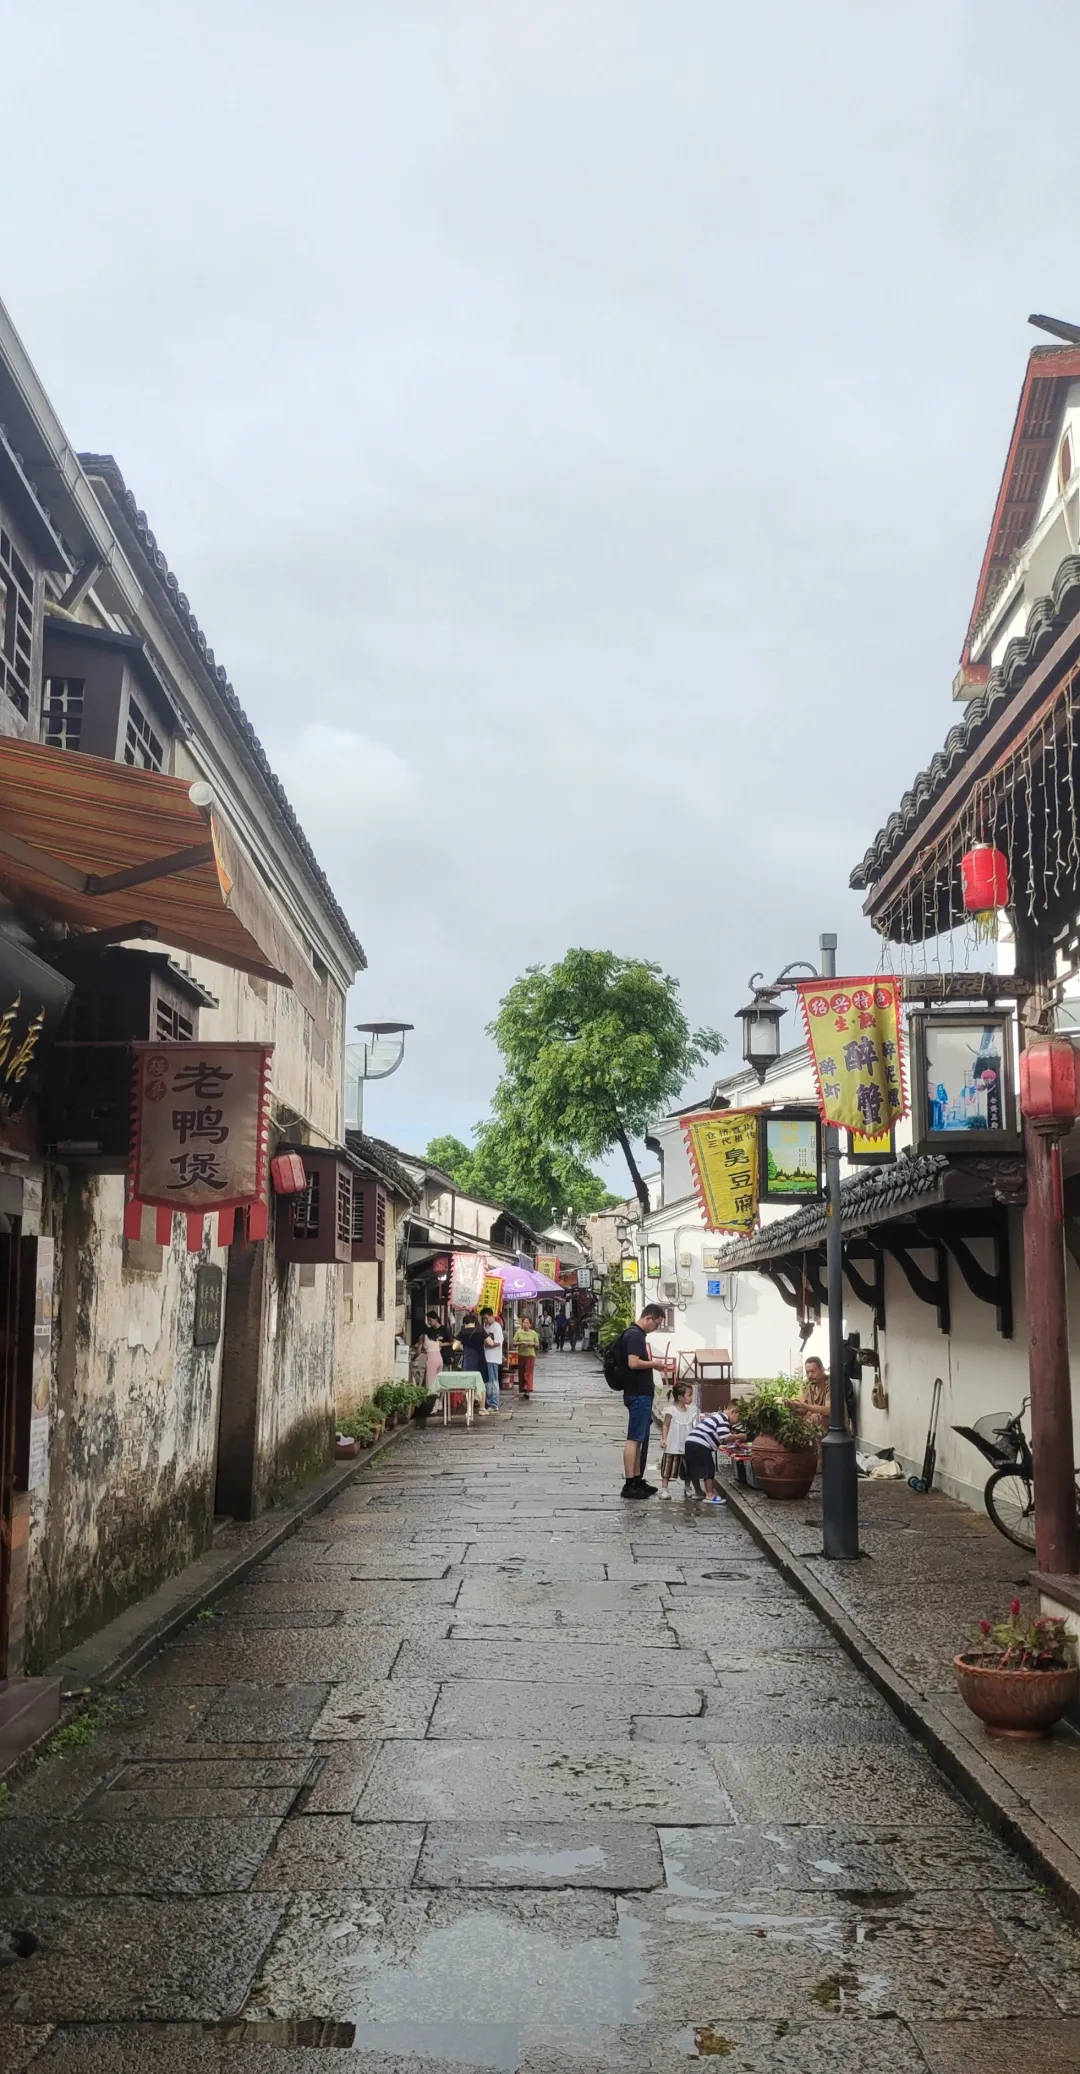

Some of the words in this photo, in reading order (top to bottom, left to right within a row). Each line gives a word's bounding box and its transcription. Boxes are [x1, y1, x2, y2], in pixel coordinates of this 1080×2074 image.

[811, 990, 890, 1016] 绍兴特色
[819, 1057, 841, 1099] 醉虾
[842, 1036, 884, 1126] 醉蟹
[881, 1040, 900, 1107] 醉泥螺
[166, 1061, 234, 1190] 老鸭煲
[708, 1131, 757, 1148] 三代祖传
[724, 1147, 754, 1213] 臭豆腐
